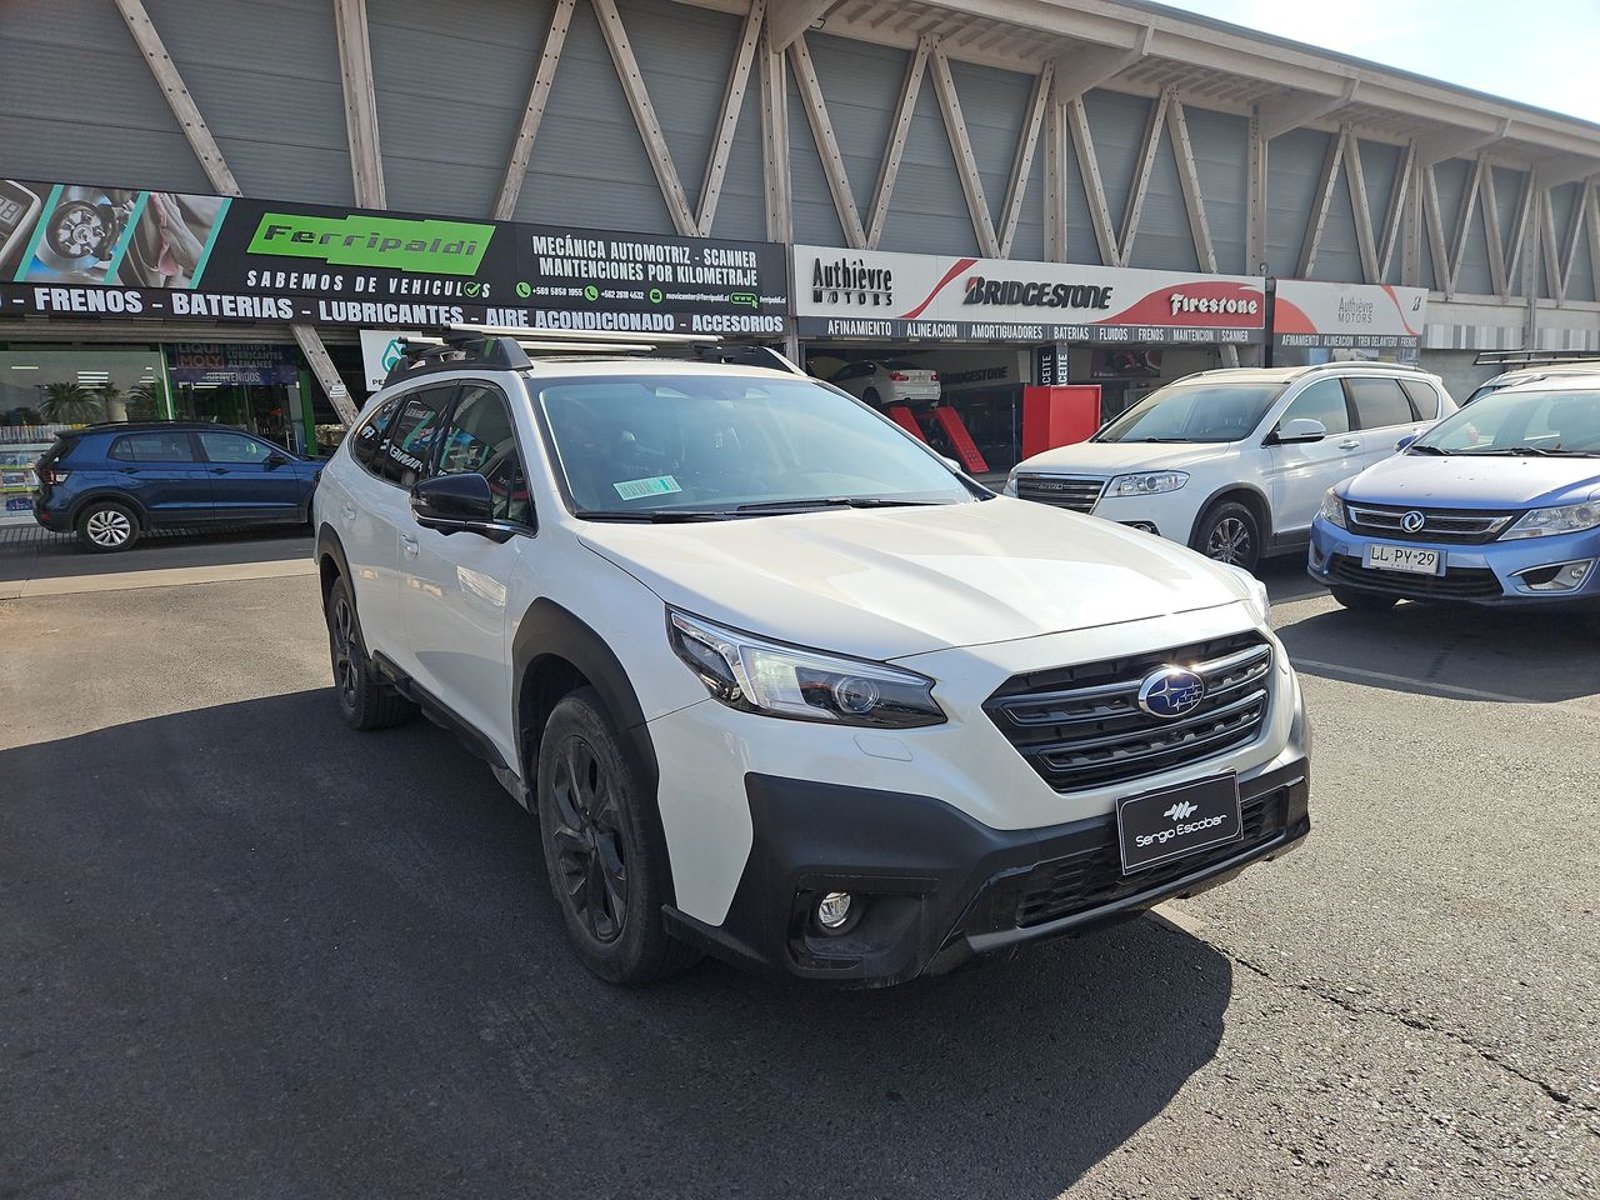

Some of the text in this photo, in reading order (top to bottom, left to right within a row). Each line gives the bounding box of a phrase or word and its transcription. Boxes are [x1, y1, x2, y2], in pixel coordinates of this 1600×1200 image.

[263, 224, 478, 256] Ferripaldi
[532, 234, 605, 259] MECÁNICA
[610, 241, 691, 264] AUTOMOTRIZ
[703, 249, 757, 268] SCANNER
[246, 270, 343, 291] SABEMOS
[355, 276, 377, 293] DE
[539, 257, 758, 286] MANTENCIONES POR KILOMETRAJE
[813, 258, 892, 291] Authièvre
[813, 290, 892, 306] MOTORS
[963, 277, 1113, 310] BRIDGESTONE
[1170, 293, 1258, 316] Firestone
[34, 287, 143, 312] FRENOS
[171, 293, 293, 319] BATERIAS
[318, 301, 463, 325] LUBRICANTES
[486, 308, 528, 328] AIRE
[535, 310, 675, 331] ACONDICIONADO
[692, 314, 784, 332] ACCESORIOS
[1339, 313, 1373, 323] MOTORS
[827, 320, 1249, 342] AFINAMIENTO ALINEACION AMORTIGUADORES BATERIAS FLUIDOS FRENOS MANTENCION SCANNER
[1281, 334, 1417, 347] AFINAMIENTO ALINEACION TREN DELANTERO FRENOS
[179, 354, 221, 366] MOLY
[1042, 354, 1052, 386] CEITE
[1057, 353, 1068, 386] CEITE
[1176, 814, 1228, 834] Escobar
